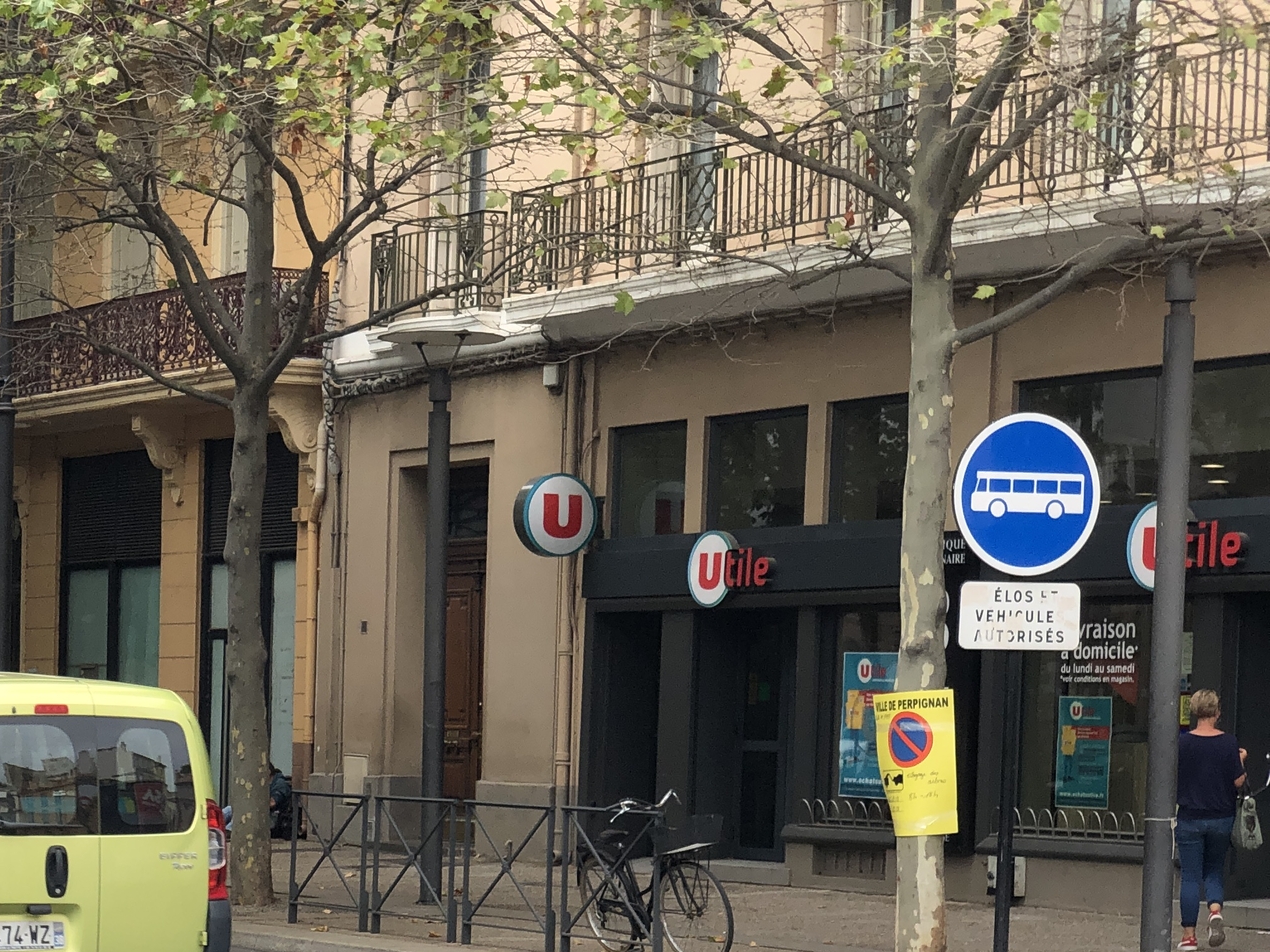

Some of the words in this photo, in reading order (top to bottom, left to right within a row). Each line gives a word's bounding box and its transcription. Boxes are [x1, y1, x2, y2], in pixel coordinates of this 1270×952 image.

[543, 493, 582, 539] U
[943, 539, 966, 552] IQUE
[698, 547, 769, 590] Utile
[1060, 663, 1071, 674] du
[1073, 663, 1093, 674] lundi
[1094, 664, 1105, 674] au
[1106, 663, 1135, 674] samedi
[1073, 675, 1102, 683] conditions
[876, 700, 888, 713] VILLE
[888, 699, 897, 711] DE
[897, 697, 949, 710] PERPIGNAN
